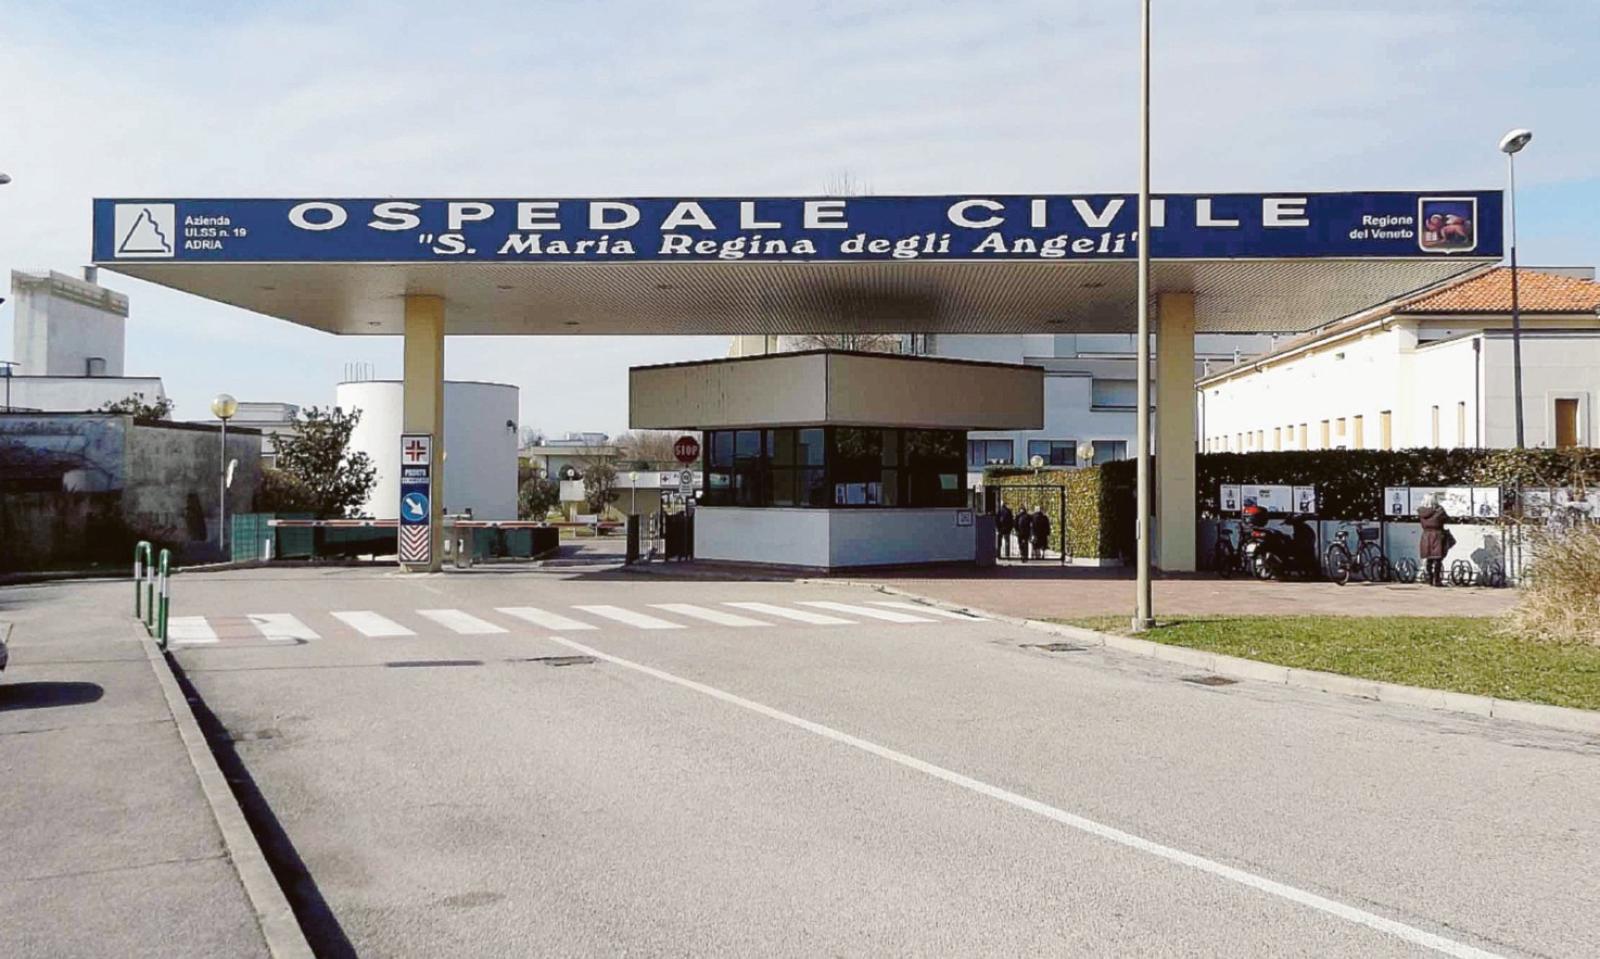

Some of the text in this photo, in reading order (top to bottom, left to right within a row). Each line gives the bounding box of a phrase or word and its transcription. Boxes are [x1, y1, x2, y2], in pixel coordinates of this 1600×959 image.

[287, 198, 1310, 231] OSPEDALE CIVILE
[184, 215, 231, 226] Azienda
[1362, 214, 1414, 228] Regione
[184, 227, 217, 237] ULSS
[233, 227, 247, 237] 19
[1349, 228, 1414, 239] del Veneto
[184, 239, 223, 250] ADRIA
[496, 233, 636, 254] Maria
[657, 233, 817, 259] Regina
[840, 232, 951, 258] degli
[675, 445, 698, 456] STOP
